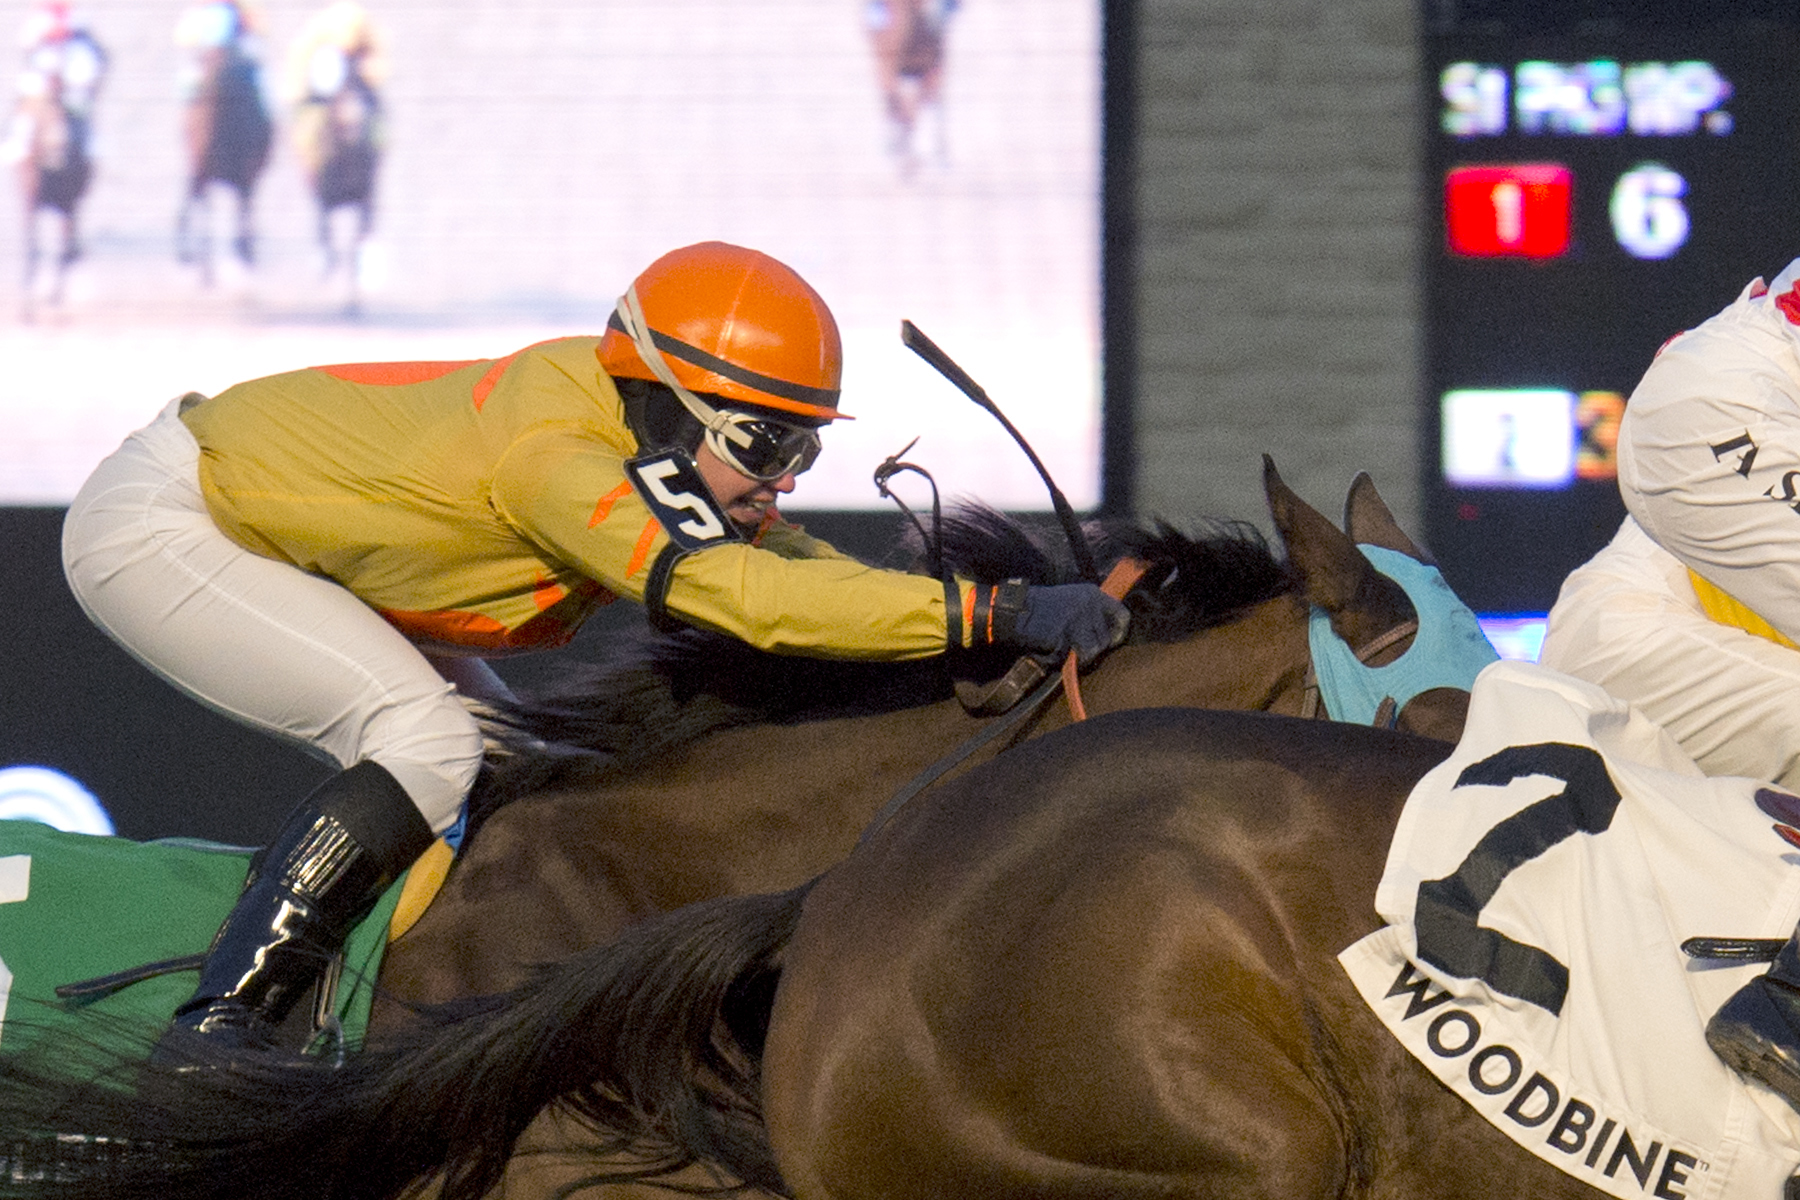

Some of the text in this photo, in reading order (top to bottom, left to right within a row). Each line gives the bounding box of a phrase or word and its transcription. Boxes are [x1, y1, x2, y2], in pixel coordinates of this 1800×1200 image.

[1488, 162, 1692, 260] 1 6
[636, 458, 725, 541] 5
[1415, 741, 1622, 1018] 2
